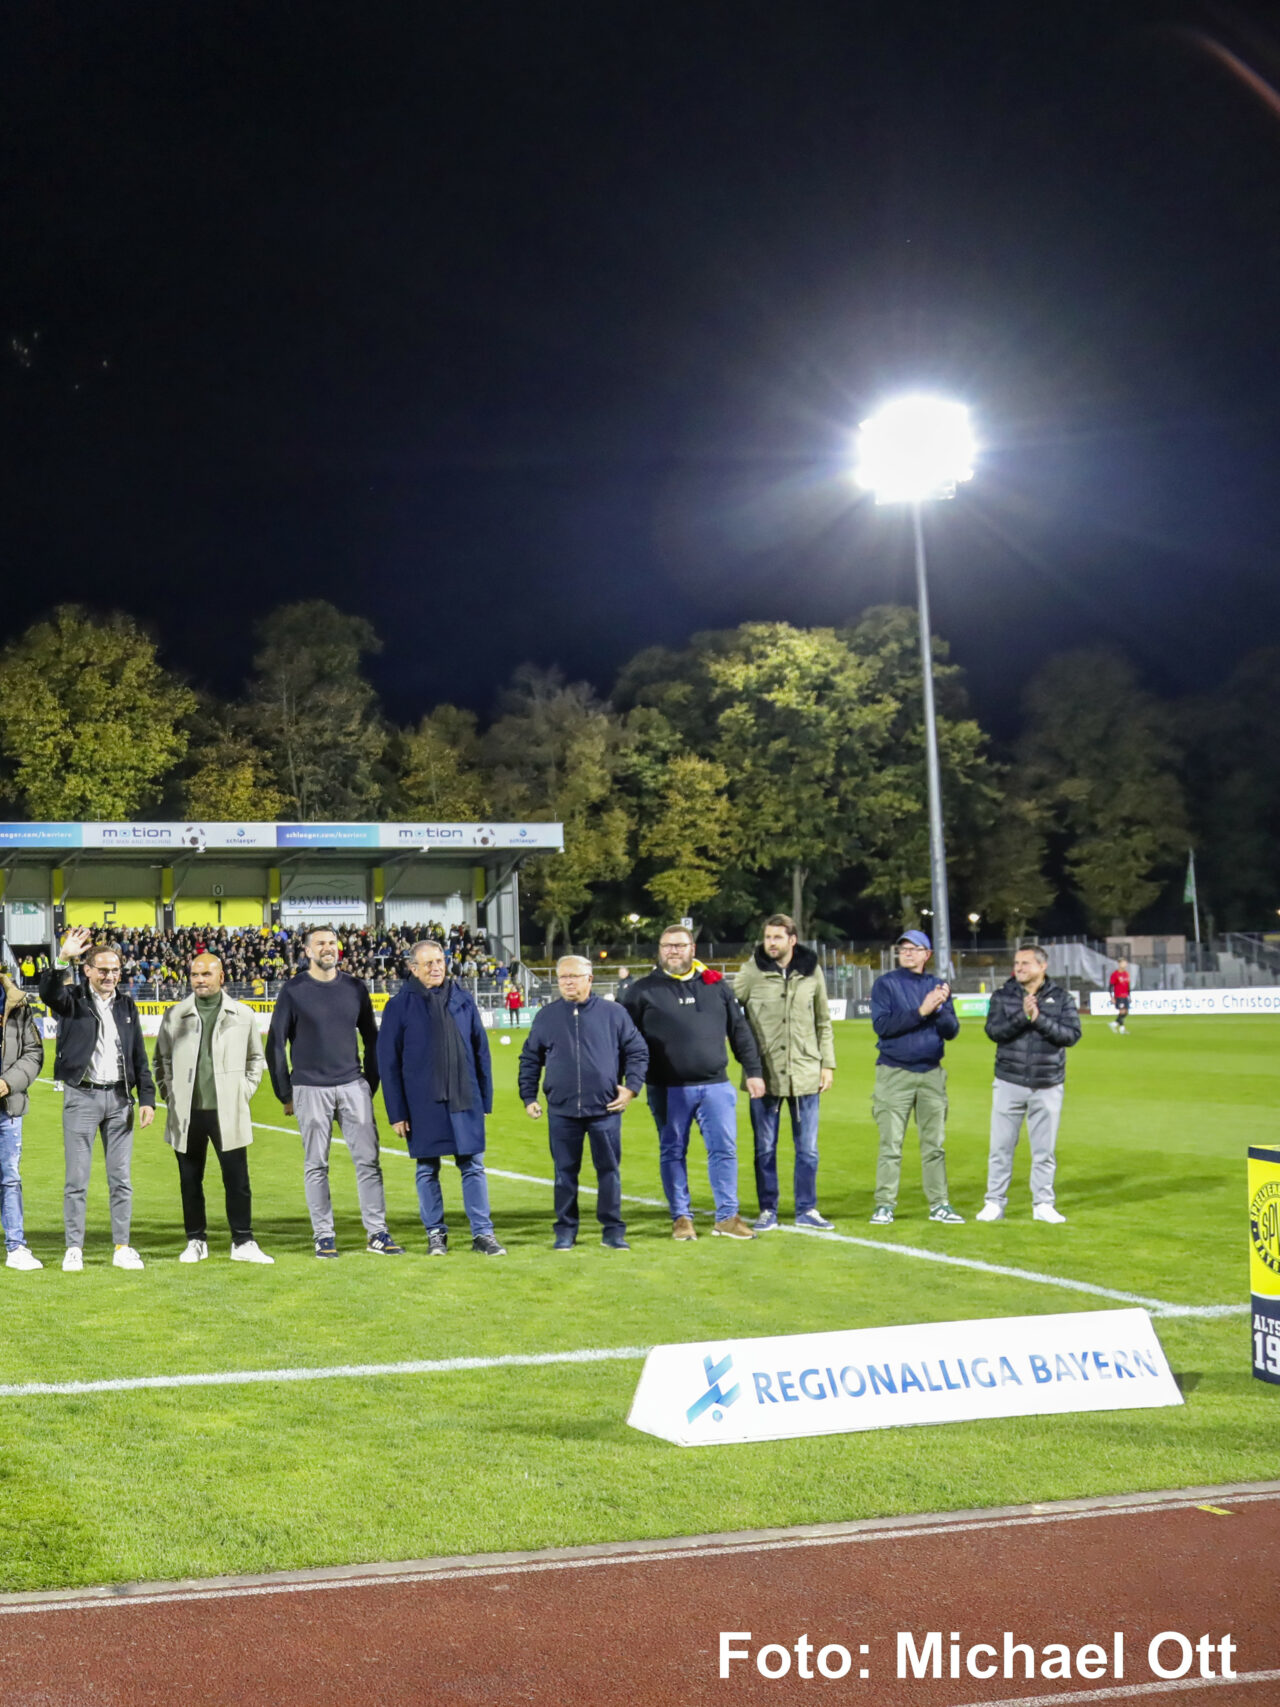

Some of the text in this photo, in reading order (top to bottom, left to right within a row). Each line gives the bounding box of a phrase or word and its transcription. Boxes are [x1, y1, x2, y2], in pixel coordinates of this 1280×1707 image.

[102, 827, 171, 838] motion
[399, 827, 463, 838] motion
[289, 895, 360, 908] BAYREUTH
[751, 1349, 1160, 1404] REGIONALLIGA BAYERN
